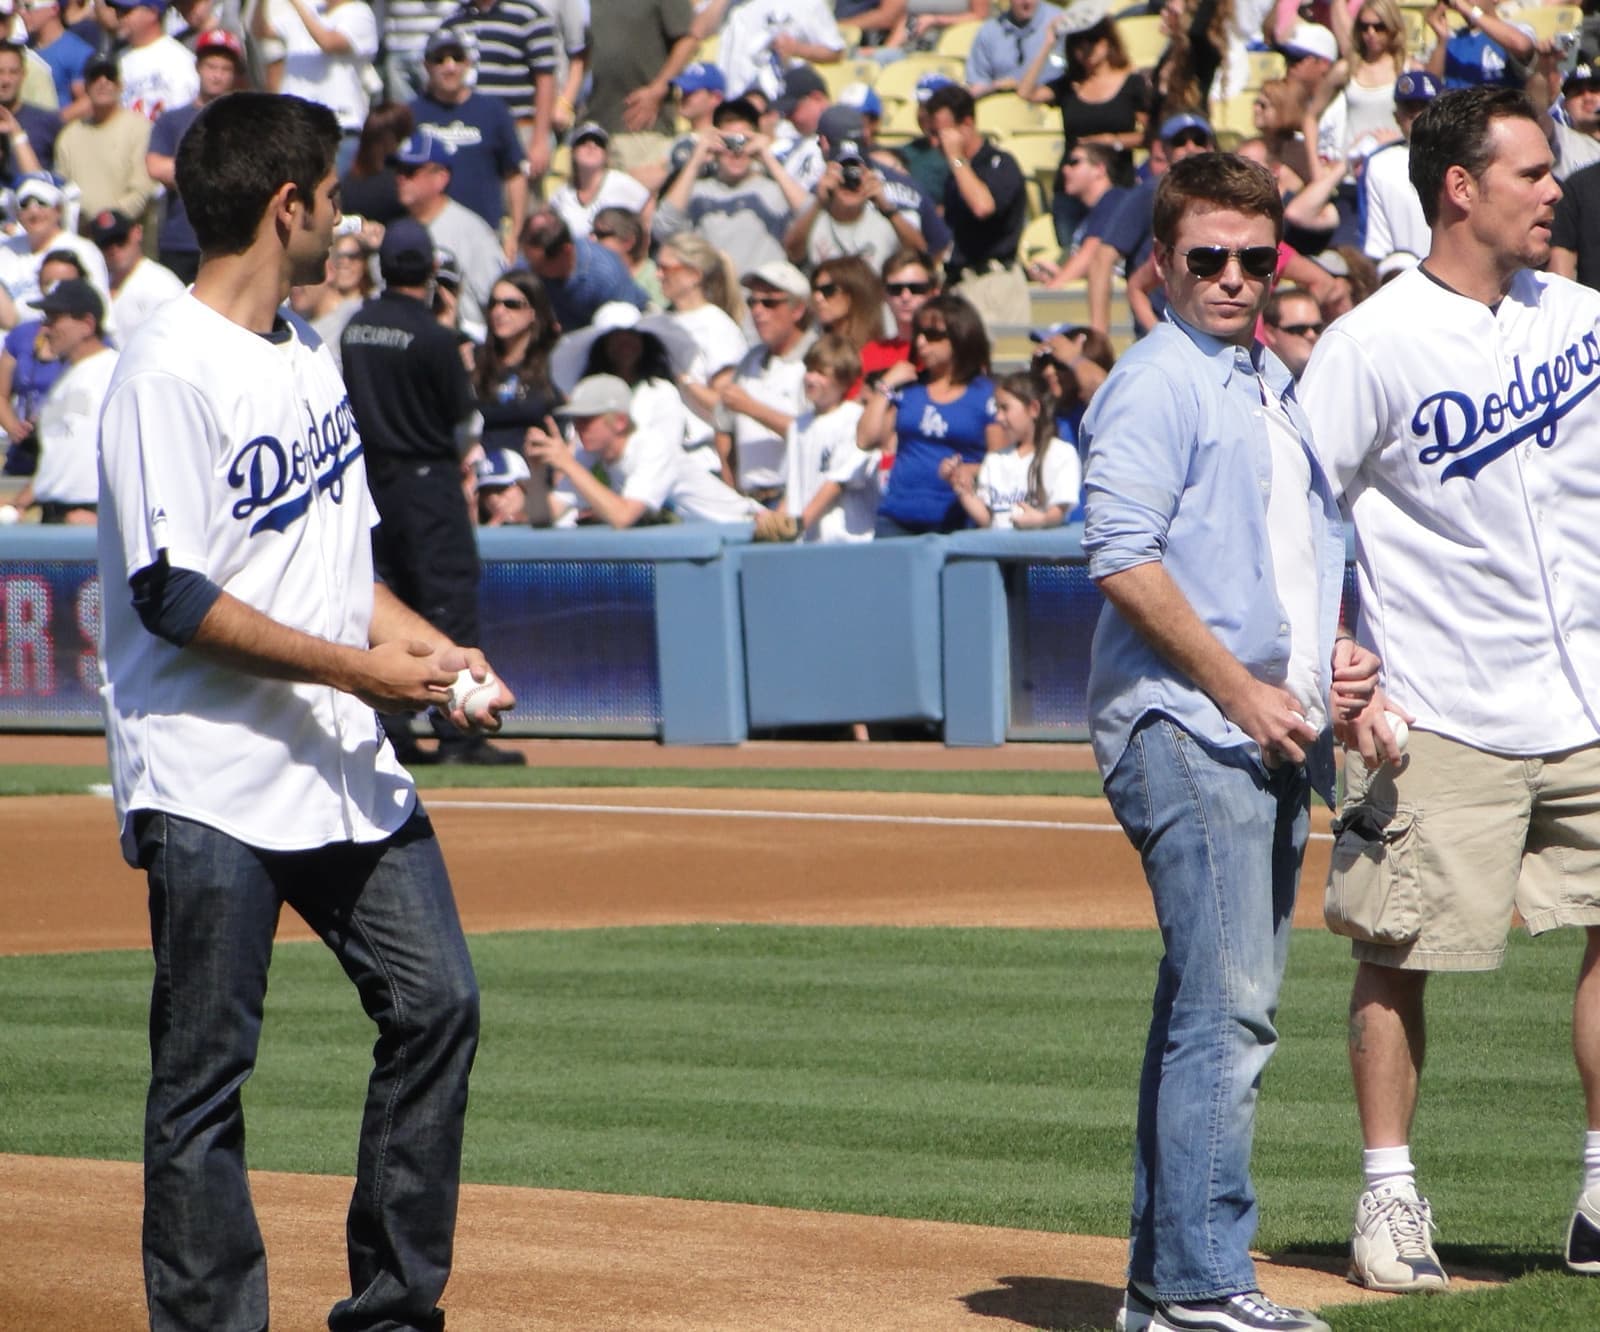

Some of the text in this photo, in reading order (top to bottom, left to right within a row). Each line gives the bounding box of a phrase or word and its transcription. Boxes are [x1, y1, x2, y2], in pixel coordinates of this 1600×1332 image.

[344, 324, 415, 350] SECURITY
[919, 404, 948, 438] LA
[1411, 328, 1600, 465] Dodgers
[227, 395, 360, 521] Dodger
